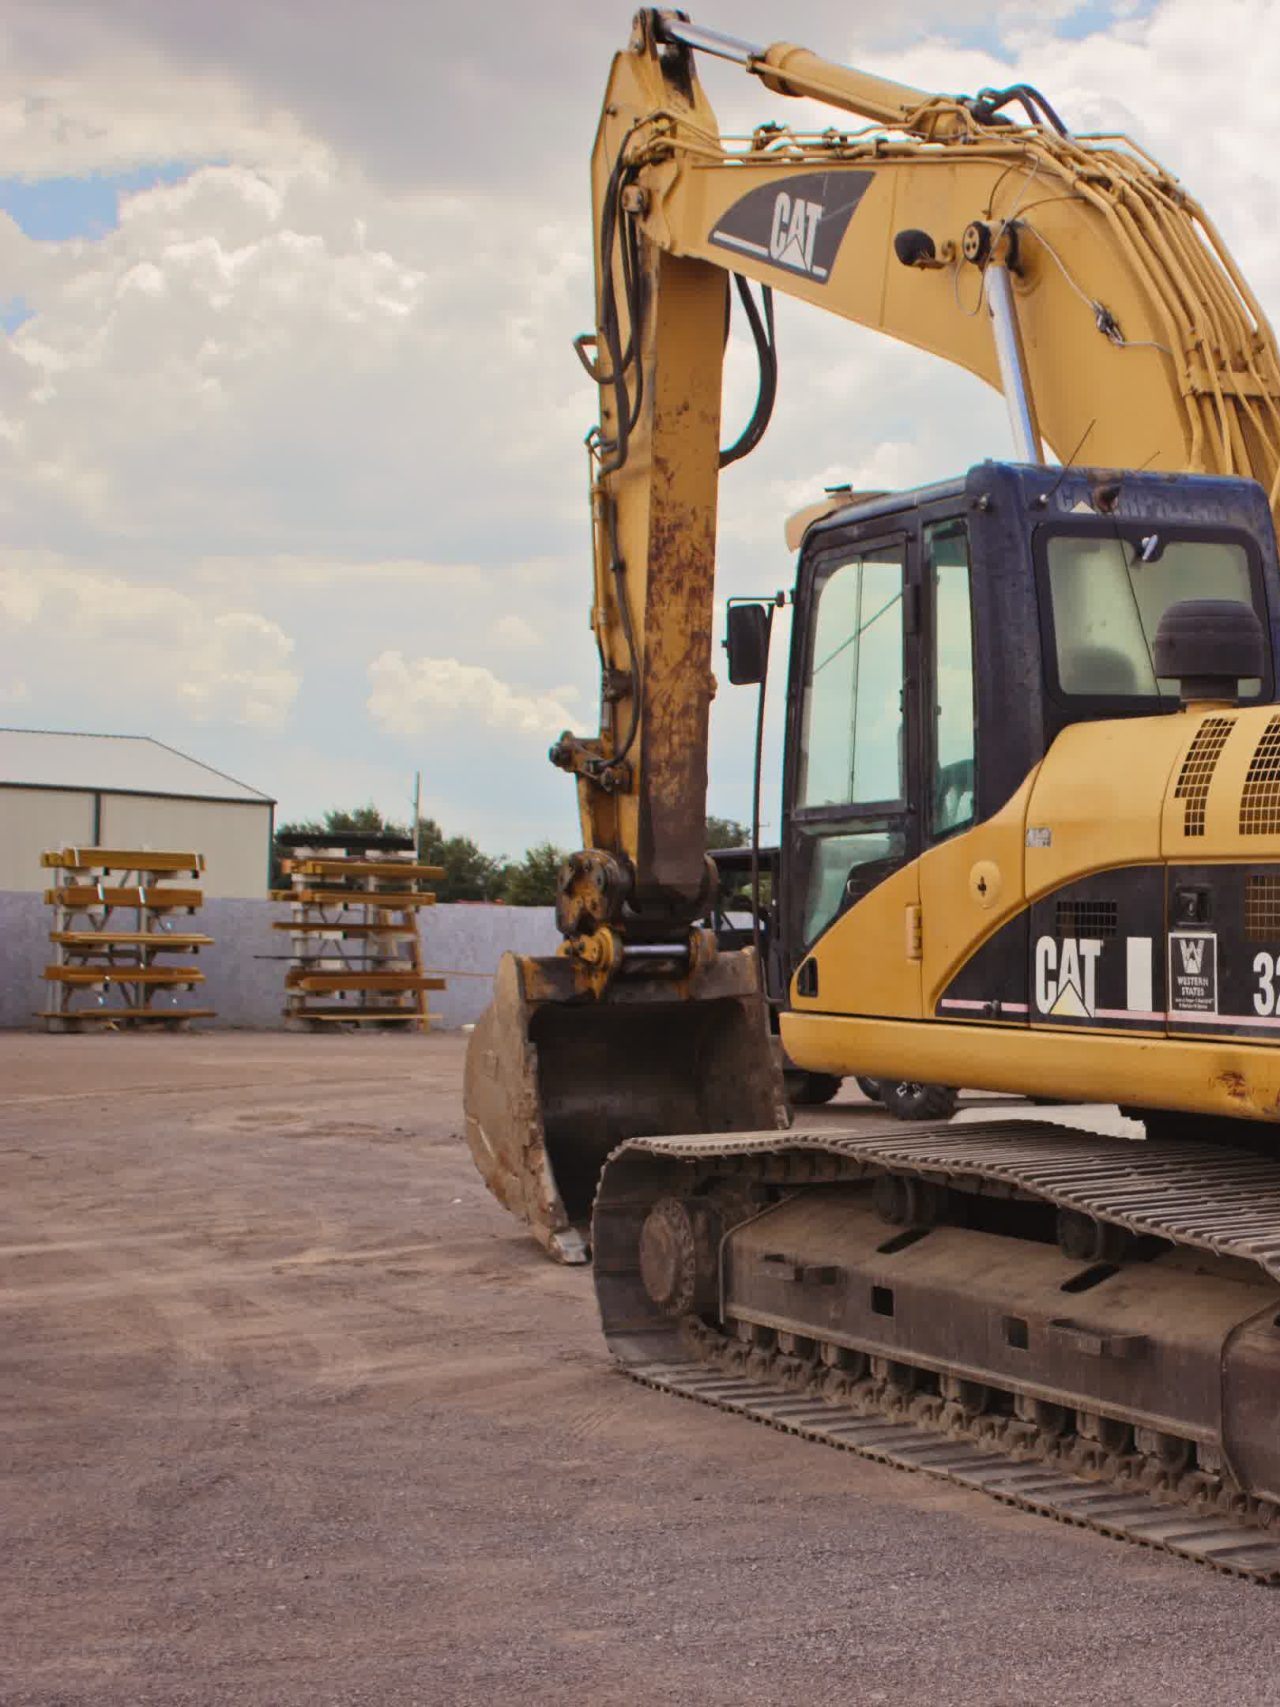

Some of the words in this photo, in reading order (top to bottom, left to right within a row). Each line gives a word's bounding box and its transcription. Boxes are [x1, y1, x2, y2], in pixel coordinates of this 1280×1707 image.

[770, 192, 823, 272] CAT
[1036, 936, 1103, 1018] CAT
[1178, 976, 1209, 986] WESTERN
[1181, 986, 1205, 996] STATES
